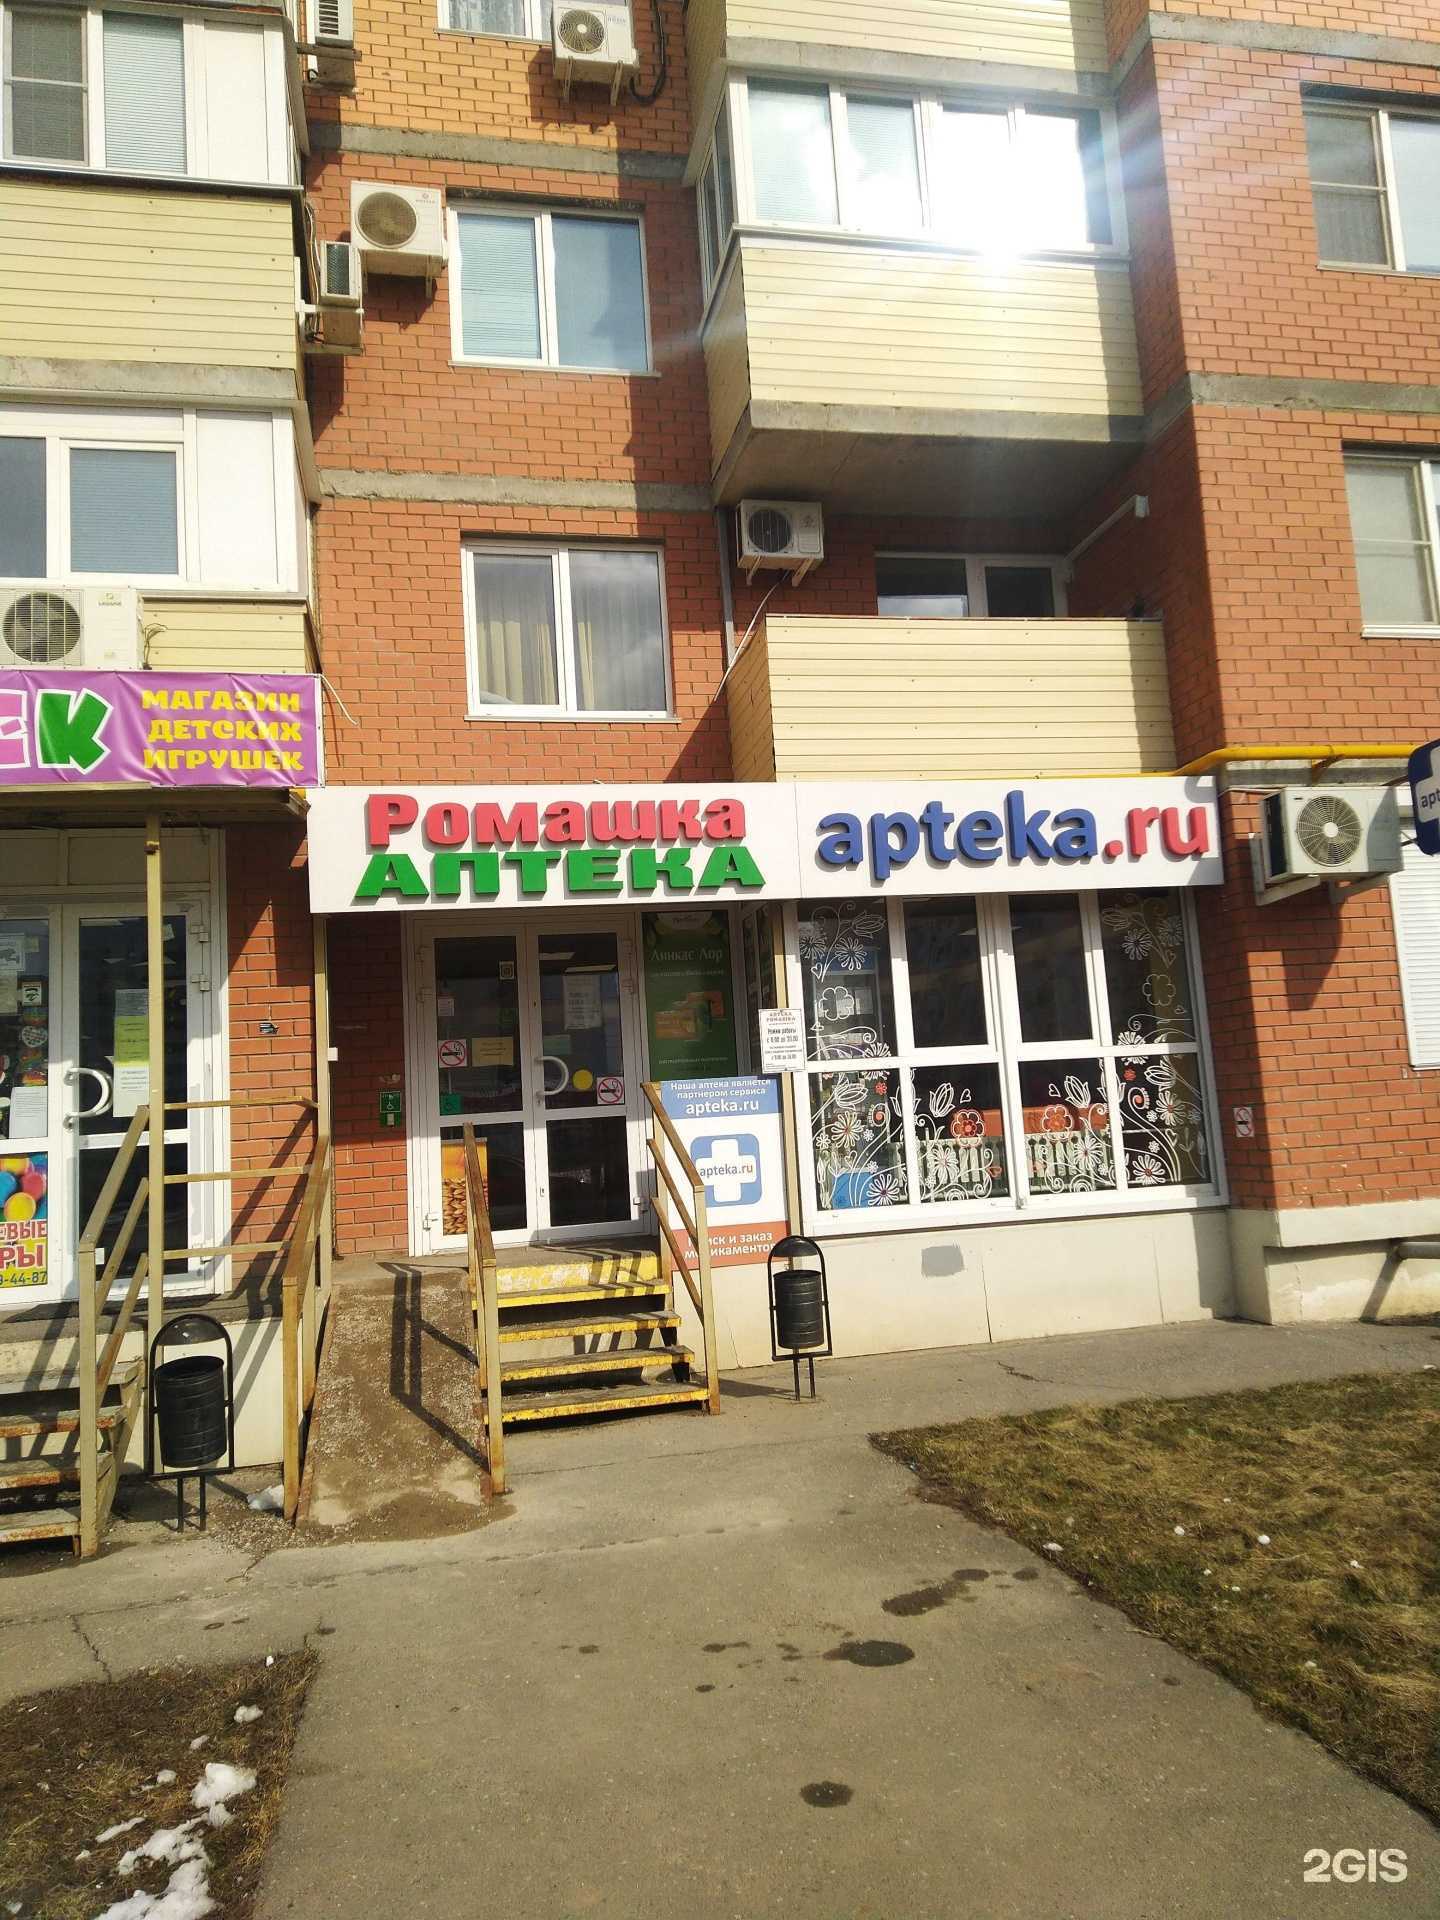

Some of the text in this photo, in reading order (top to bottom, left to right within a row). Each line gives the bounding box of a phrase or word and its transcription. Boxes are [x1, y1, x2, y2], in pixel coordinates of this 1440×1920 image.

[142, 690, 301, 712] МАГАЗИН
[147, 719, 303, 743] ДЕТСКИХ
[143, 749, 304, 770] ИГРУШЕК
[367, 793, 747, 847] Ромашка
[816, 789, 1210, 881] apteka.ru
[353, 845, 767, 898] АПТЕКА
[670, 1078, 771, 1091] Наша аптека является
[676, 1089, 766, 1100] партнером сервиса
[685, 1099, 759, 1116] apteka.ru
[699, 1163, 753, 1178] apteka.ru
[739, 1232, 773, 1243] заказ
[0, 1245, 44, 1269] РЫ
[684, 1243, 776, 1259] микаменто
